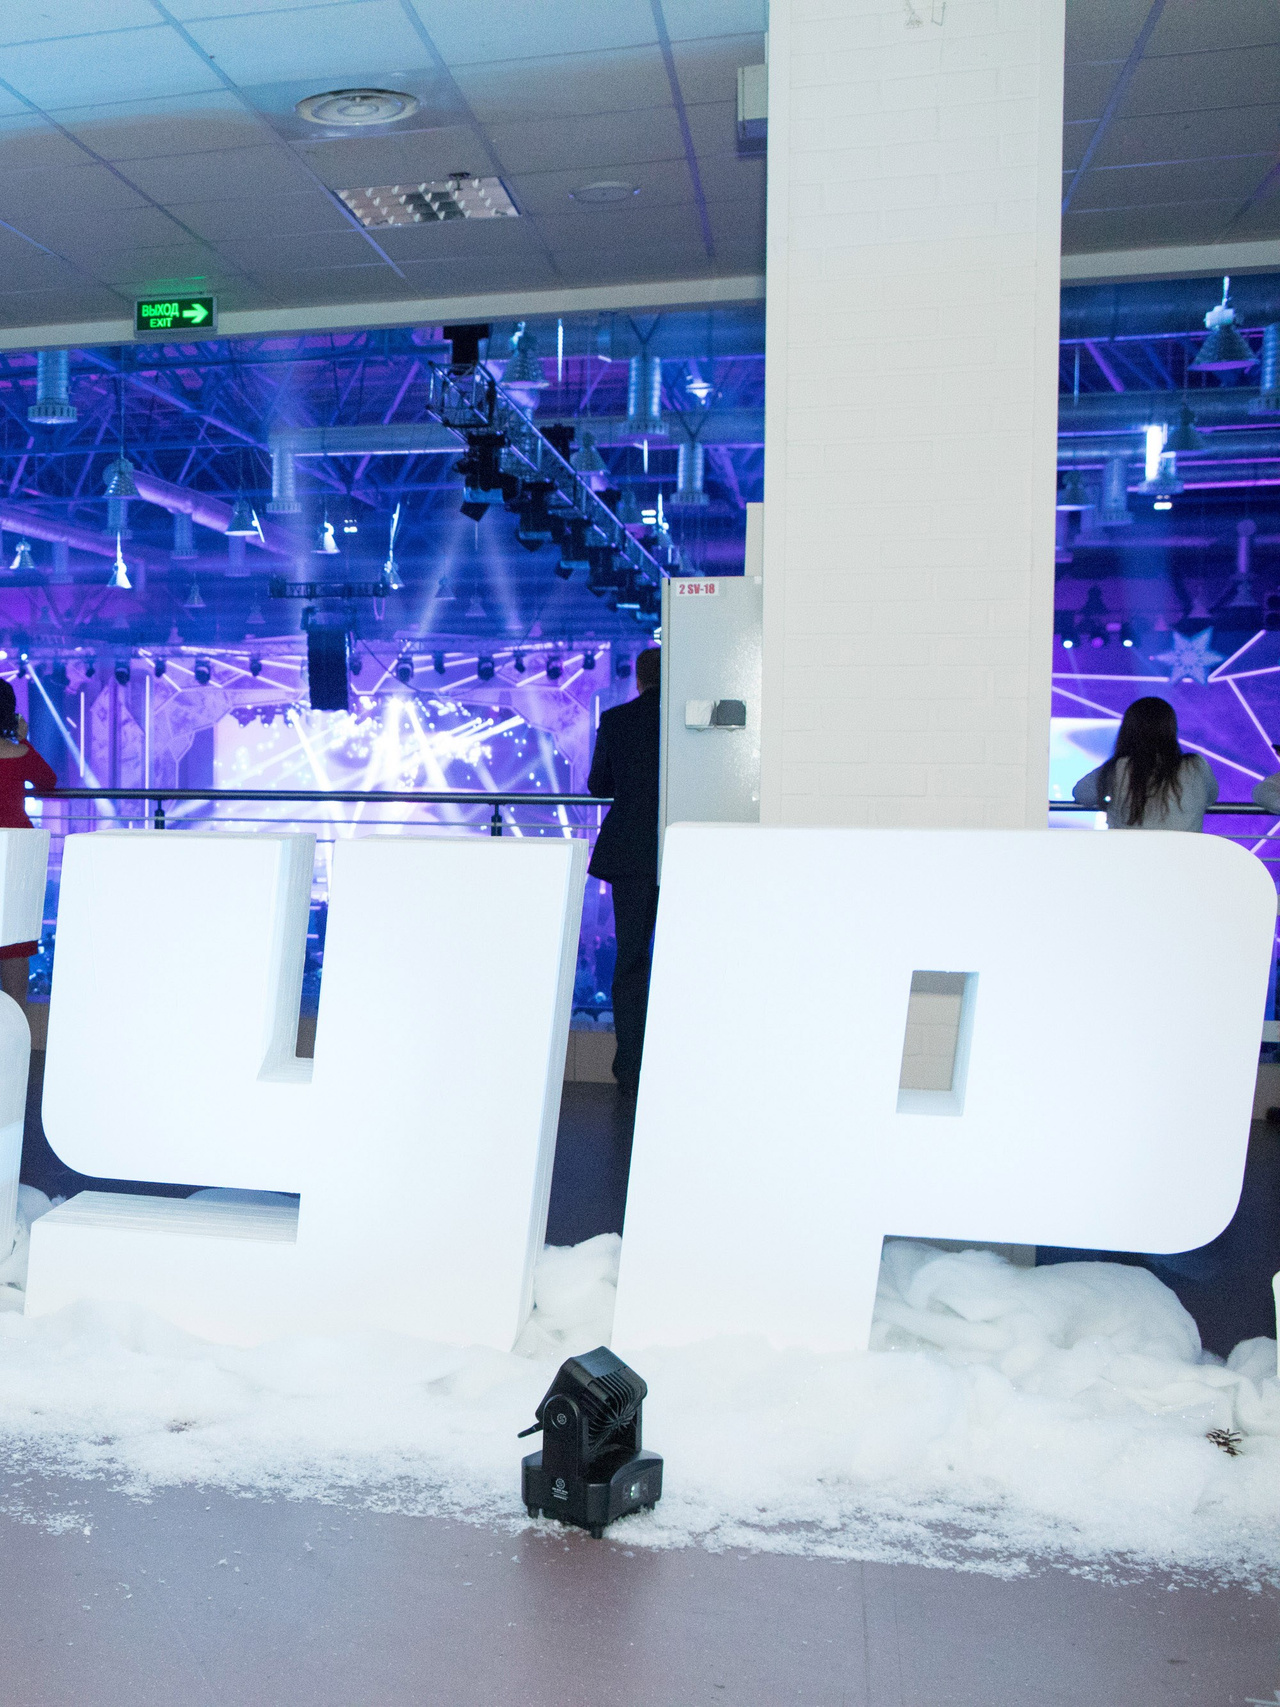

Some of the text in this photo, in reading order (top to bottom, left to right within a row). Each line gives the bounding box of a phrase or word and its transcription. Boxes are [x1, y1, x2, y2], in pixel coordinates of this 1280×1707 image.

[141, 302, 180, 318] ВЫХОД
[149, 317, 173, 328] EXIT
[679, 583, 715, 595] 2 SV-18
